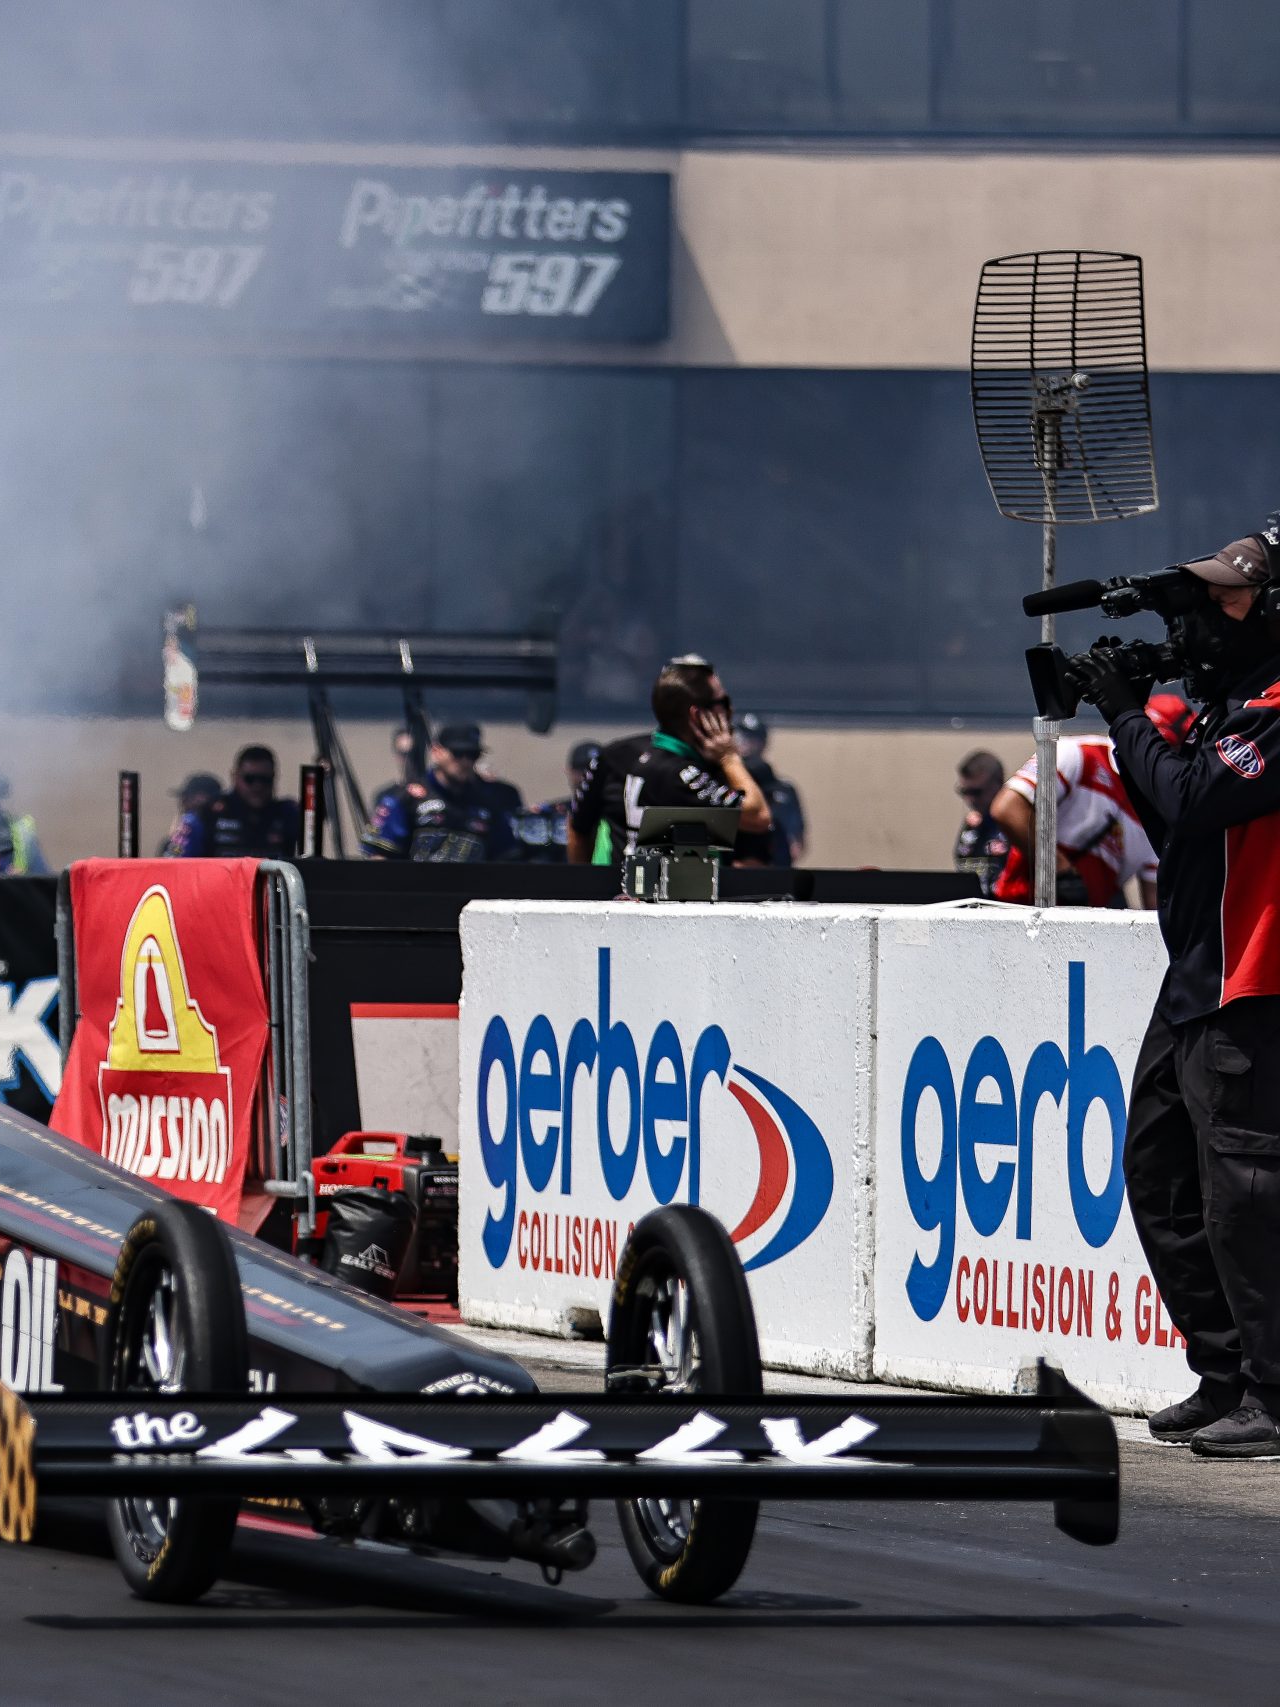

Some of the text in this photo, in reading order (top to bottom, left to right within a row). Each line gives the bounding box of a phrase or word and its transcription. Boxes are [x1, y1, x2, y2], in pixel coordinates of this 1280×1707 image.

[338, 179, 631, 248] Pipefitters
[127, 243, 266, 306] 597
[480, 253, 622, 316] 597
[1222, 738, 1258, 774] NHRA
[477, 946, 732, 1269] gerber
[517, 1210, 618, 1280] COLLISION
[0, 1249, 65, 1394] OIL
[955, 1254, 1094, 1338] COLLISION
[1105, 1271, 1122, 1342] &
[111, 1410, 207, 1447] the
